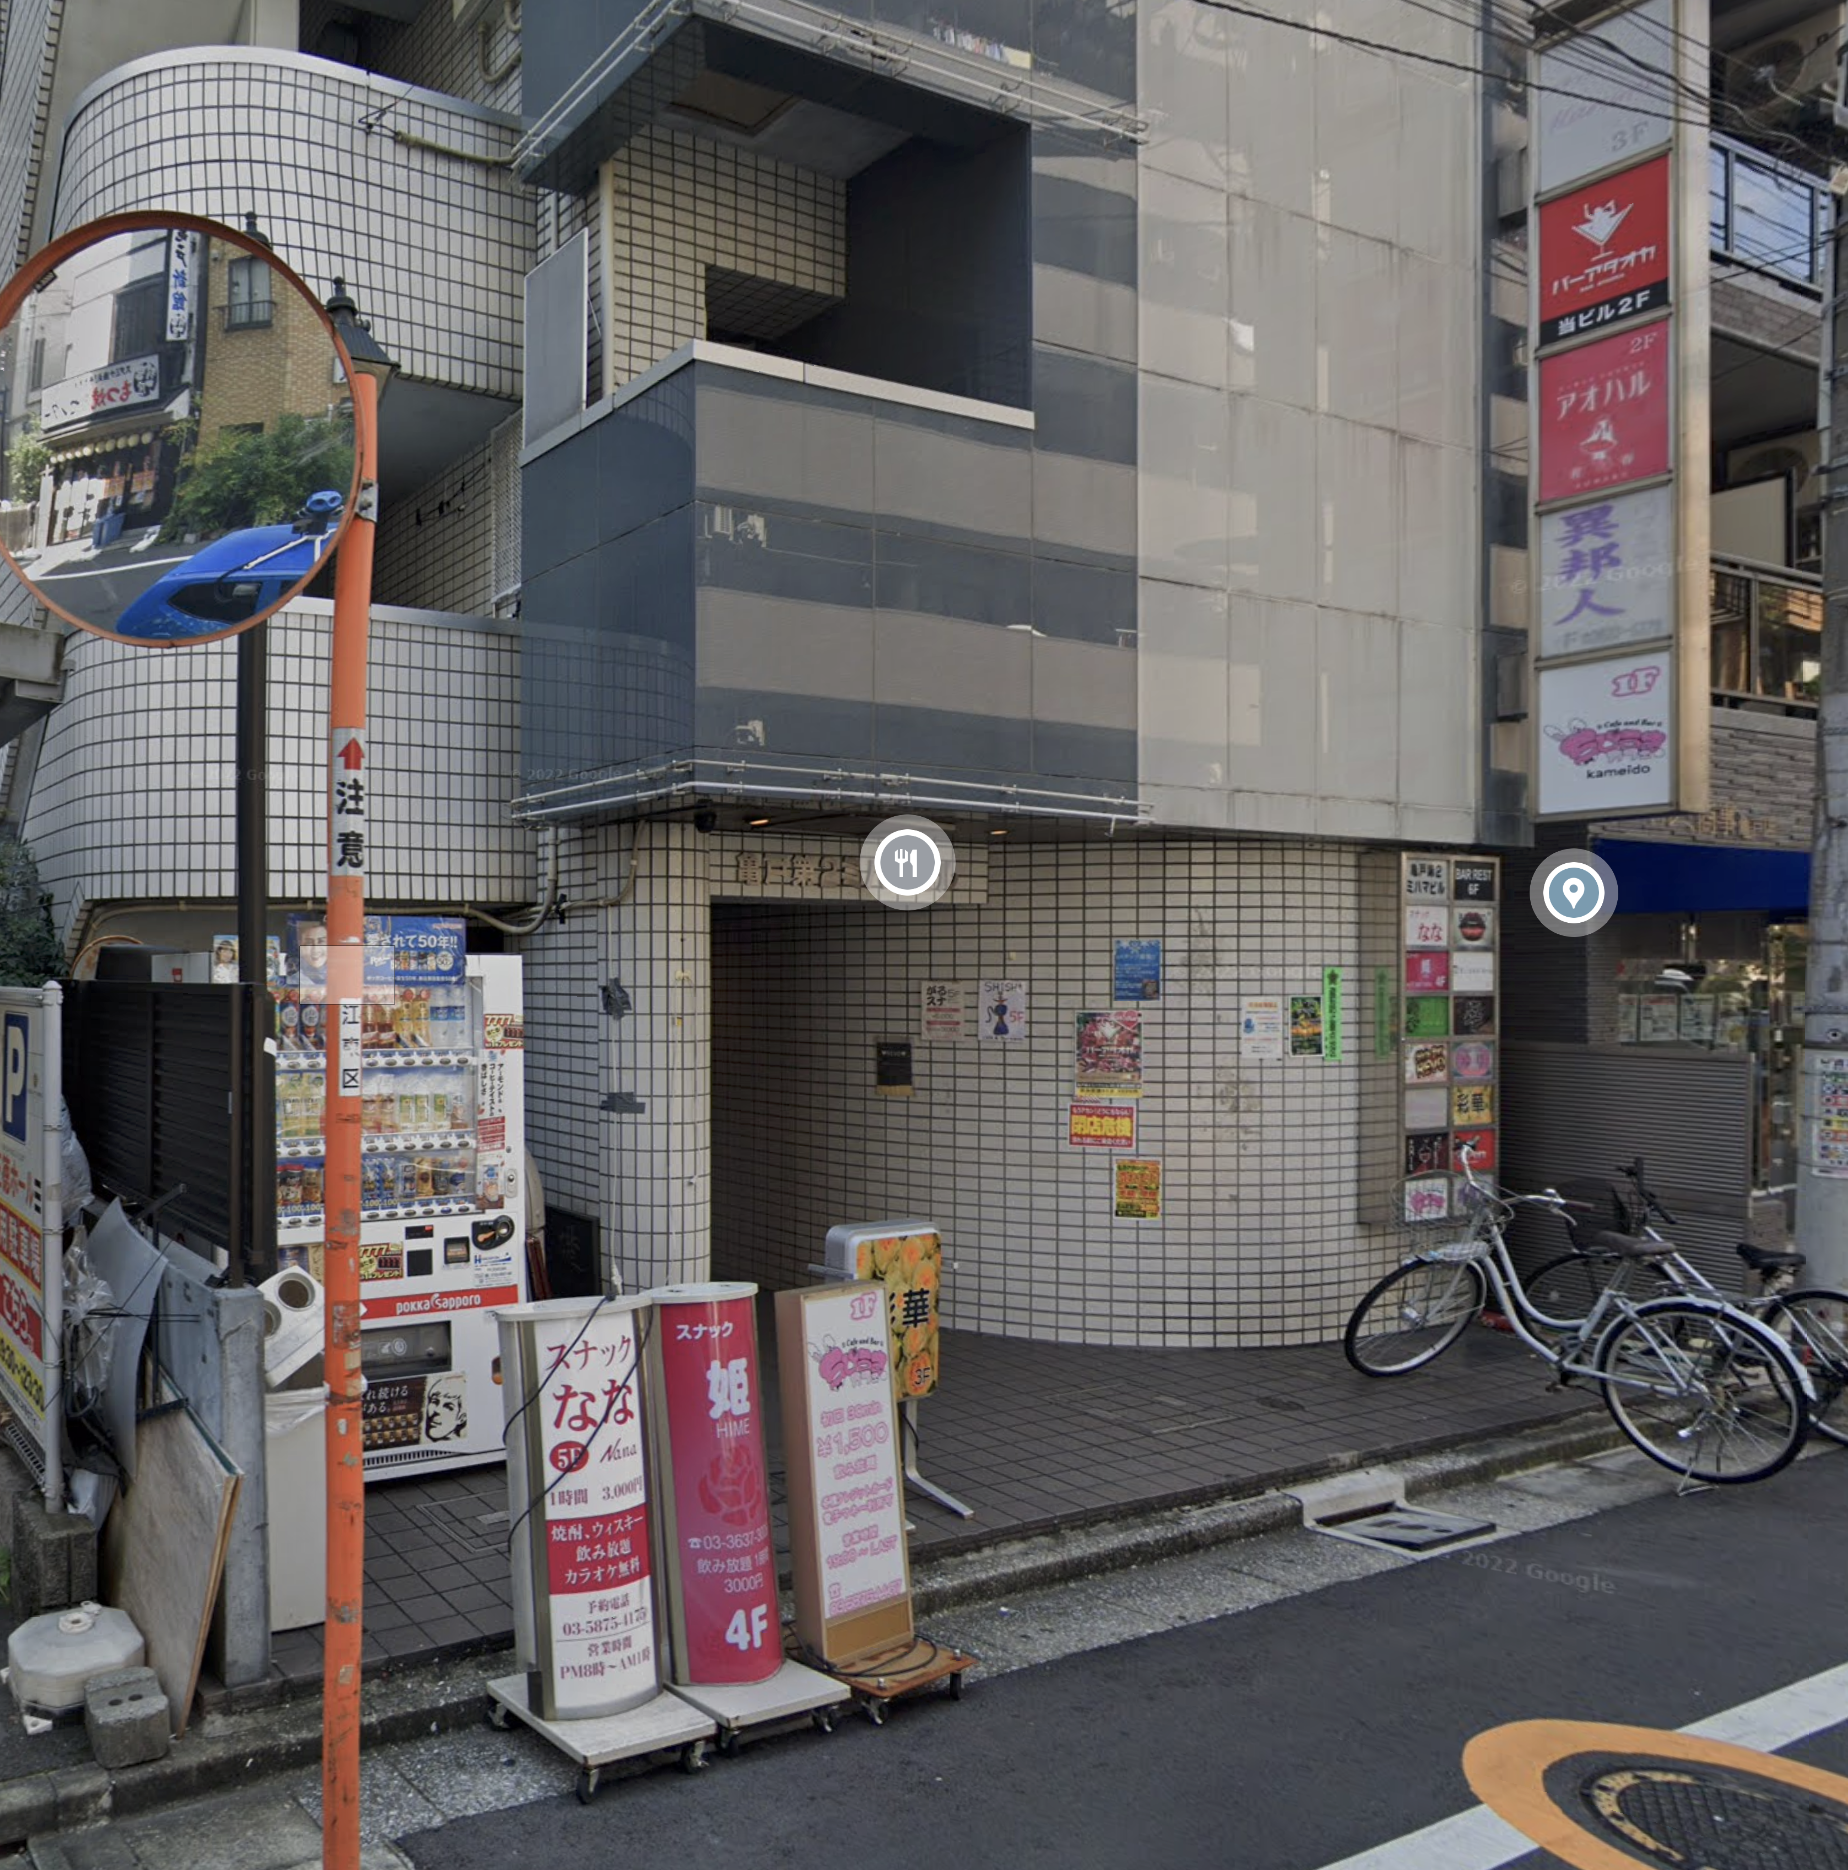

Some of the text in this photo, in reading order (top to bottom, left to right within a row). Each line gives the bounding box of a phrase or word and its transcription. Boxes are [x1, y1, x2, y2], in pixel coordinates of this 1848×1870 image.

[1551, 244, 1657, 296] バーアタオカ
[1557, 288, 1651, 337] 当ビル2F
[1630, 332, 1659, 355] 2F
[1556, 370, 1651, 421] アオハル
[1554, 503, 1626, 627] 異邦人
[1586, 764, 1651, 780] kameido
[336, 778, 365, 868] 注意
[1455, 868, 1493, 881] BAR REST
[1405, 880, 1446, 896] ミハマビル
[1417, 922, 1443, 943] なな
[6, 1025, 26, 1123] P
[676, 1321, 734, 1341] スナック
[545, 1334, 632, 1371] スナック
[706, 1358, 750, 1420] 姫
[914, 1367, 931, 1386] 3F
[362, 1384, 409, 1402] れ続ける
[552, 1379, 635, 1432] なな
[716, 1418, 751, 1439] HIME
[816, 1421, 889, 1458] ¥1,500
[557, 1437, 638, 1469] 5F Nana
[550, 1488, 589, 1506] 1時間
[551, 1515, 644, 1542] 焼酎、ウィスキー
[576, 1537, 632, 1563] 飲み放題
[564, 1556, 640, 1586] カラオケ無料
[697, 1556, 752, 1575] 飲み放題
[587, 1593, 630, 1615] 予約電話
[725, 1604, 769, 1651] 4F
[587, 1635, 633, 1657] 営業時間
